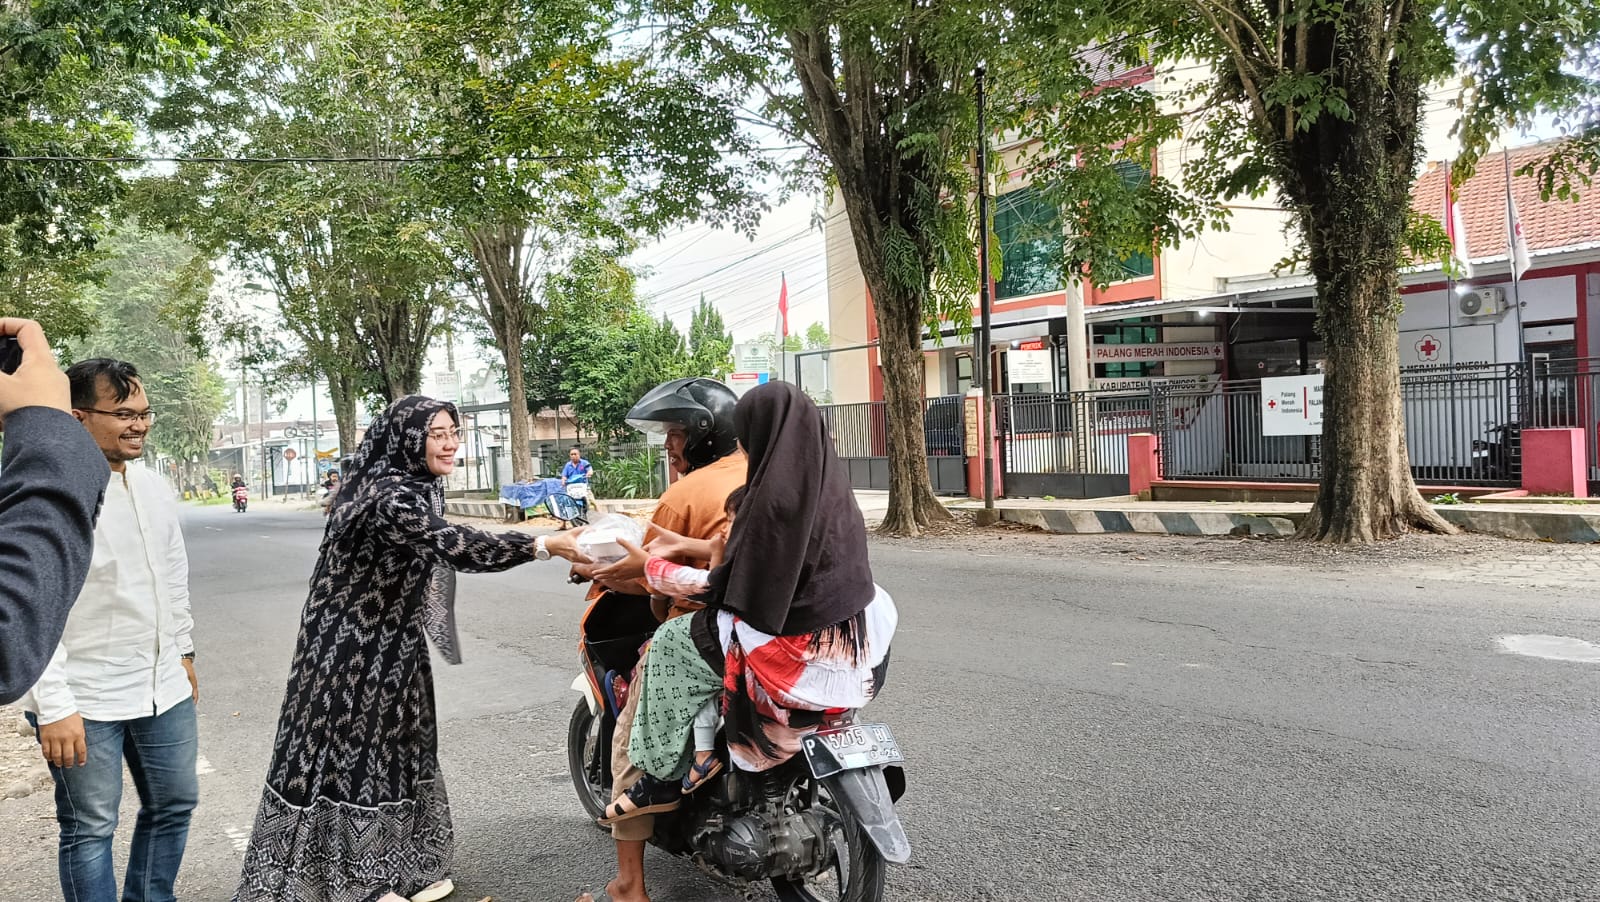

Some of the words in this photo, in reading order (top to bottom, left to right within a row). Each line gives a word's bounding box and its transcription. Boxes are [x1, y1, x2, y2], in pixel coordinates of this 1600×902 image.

[1097, 348, 1132, 358] PALANG
[1134, 347, 1163, 357] MERAH
[1166, 346, 1209, 356] INDONESIA
[1440, 360, 1490, 372] INONESIA
[1100, 380, 1146, 391] KABUPATEN
[805, 739, 816, 756] P
[828, 728, 865, 749] 5205
